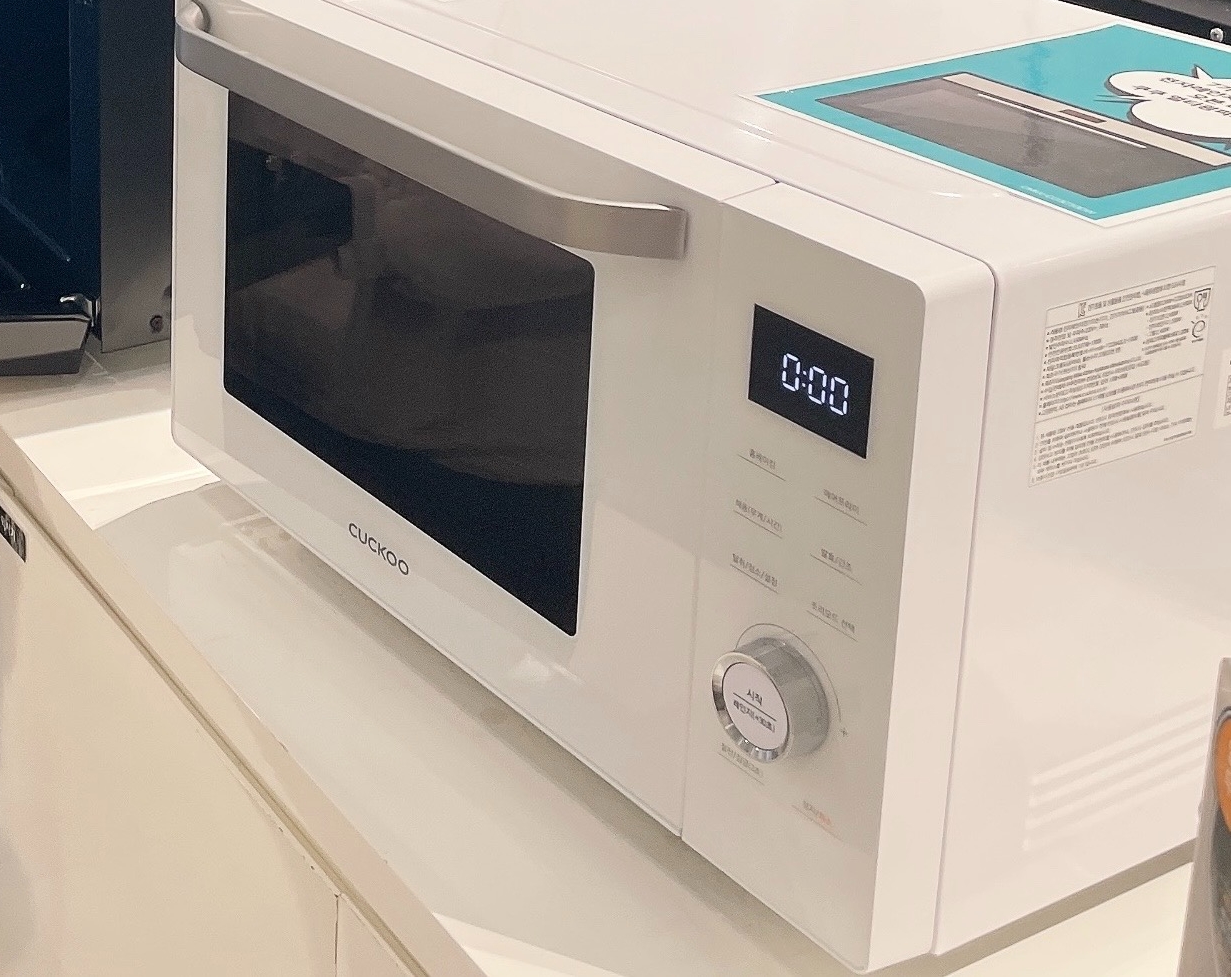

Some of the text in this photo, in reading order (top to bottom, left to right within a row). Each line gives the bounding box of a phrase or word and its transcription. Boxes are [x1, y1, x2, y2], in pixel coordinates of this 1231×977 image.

[782, 353, 849, 416] 0:00
[349, 523, 409, 575] CUCKOO
[747, 689, 763, 706] 시작
